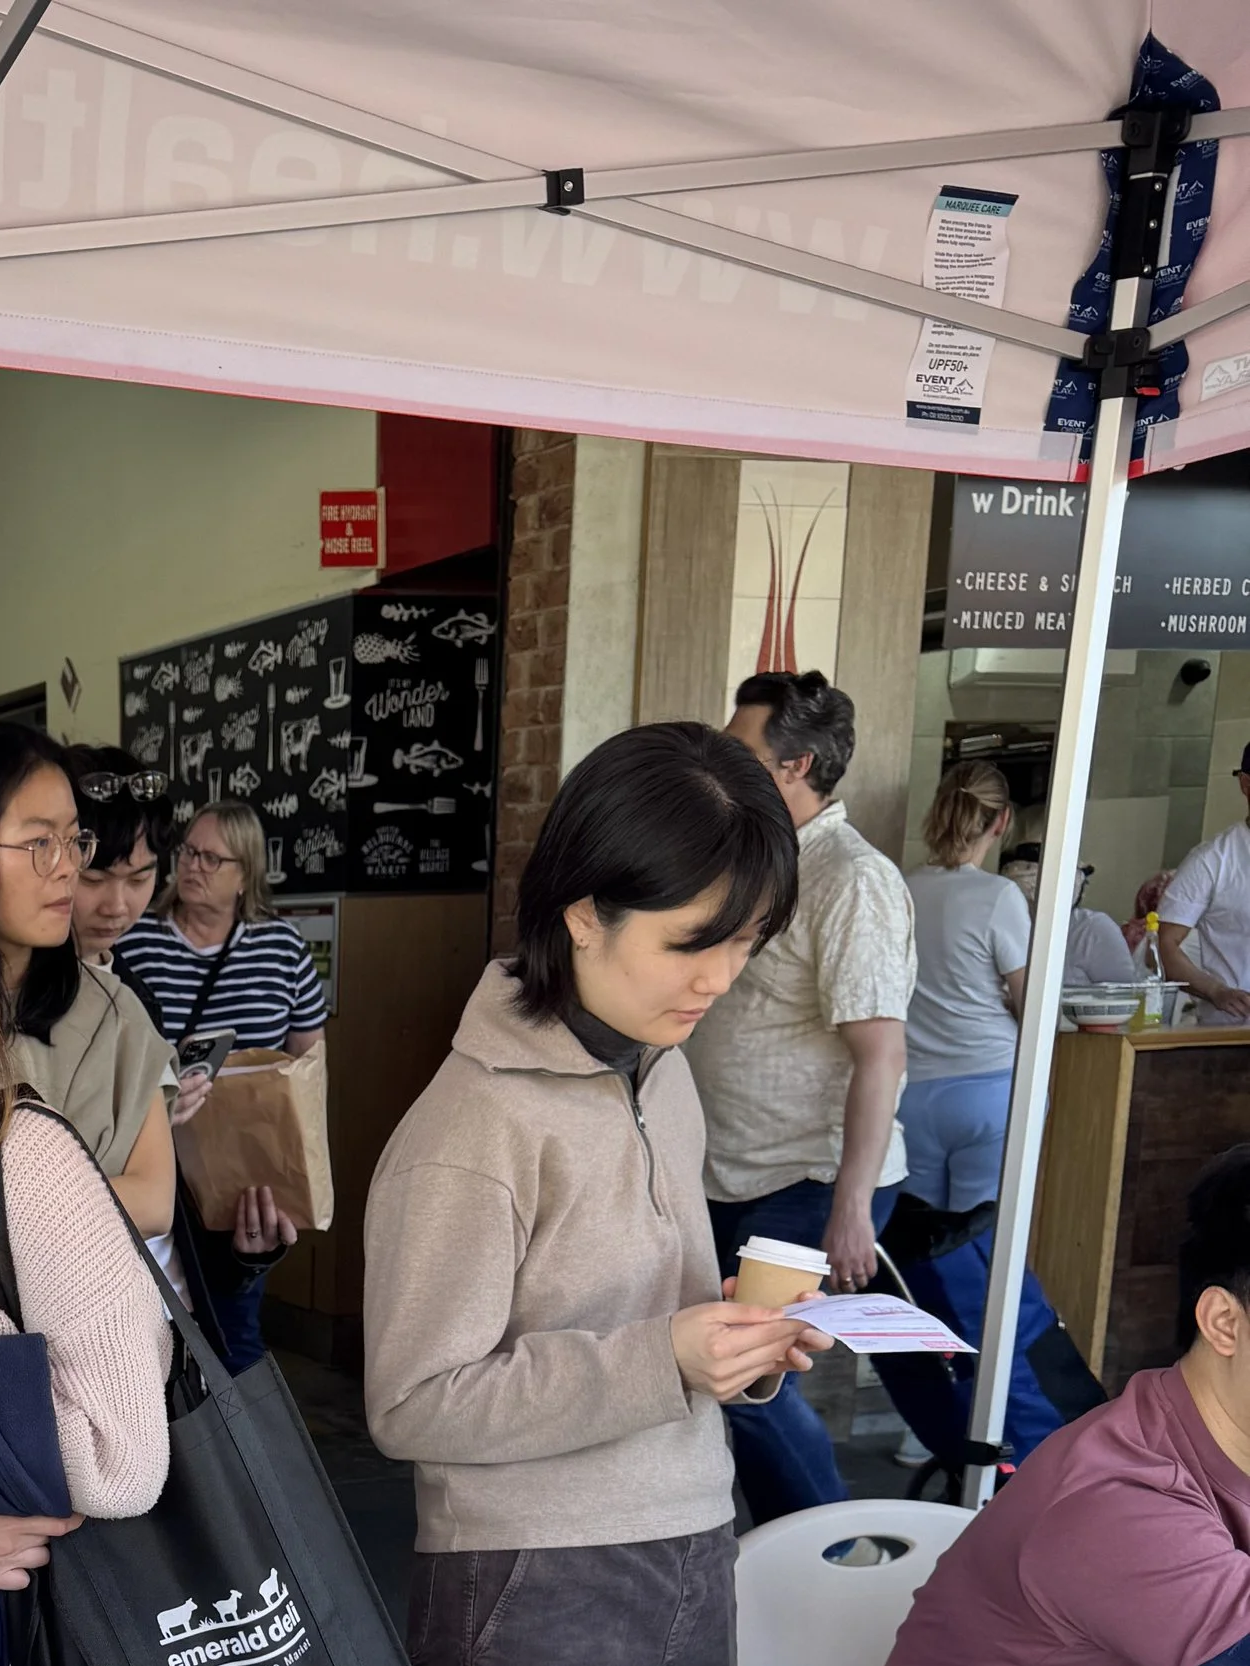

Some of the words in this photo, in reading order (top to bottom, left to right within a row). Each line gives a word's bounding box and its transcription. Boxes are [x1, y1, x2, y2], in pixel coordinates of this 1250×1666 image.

[944, 200, 980, 213] MARQUEE
[981, 204, 1002, 215] CARE
[928, 358, 969, 372] UPF50+
[916, 373, 956, 385] EVENT
[922, 384, 966, 394] DISPLAY
[1057, 417, 1087, 428] EVENT
[1001, 485, 1076, 517] Drink
[322, 504, 340, 521] FIRE
[324, 537, 350, 554] HOSE
[350, 536, 374, 553] REEL
[964, 571, 1029, 592] CHEESE
[1039, 576, 1049, 592] &
[1171, 577, 1232, 596] HERBED
[960, 611, 1025, 630] MINCED
[1035, 612, 1072, 631] MEA
[1167, 614, 1247, 633] MUSHROOM
[364, 679, 450, 722] Wonder
[402, 703, 435, 728] LAND
[268, 1600, 301, 1642] deli
[283, 1637, 312, 1666] Market
